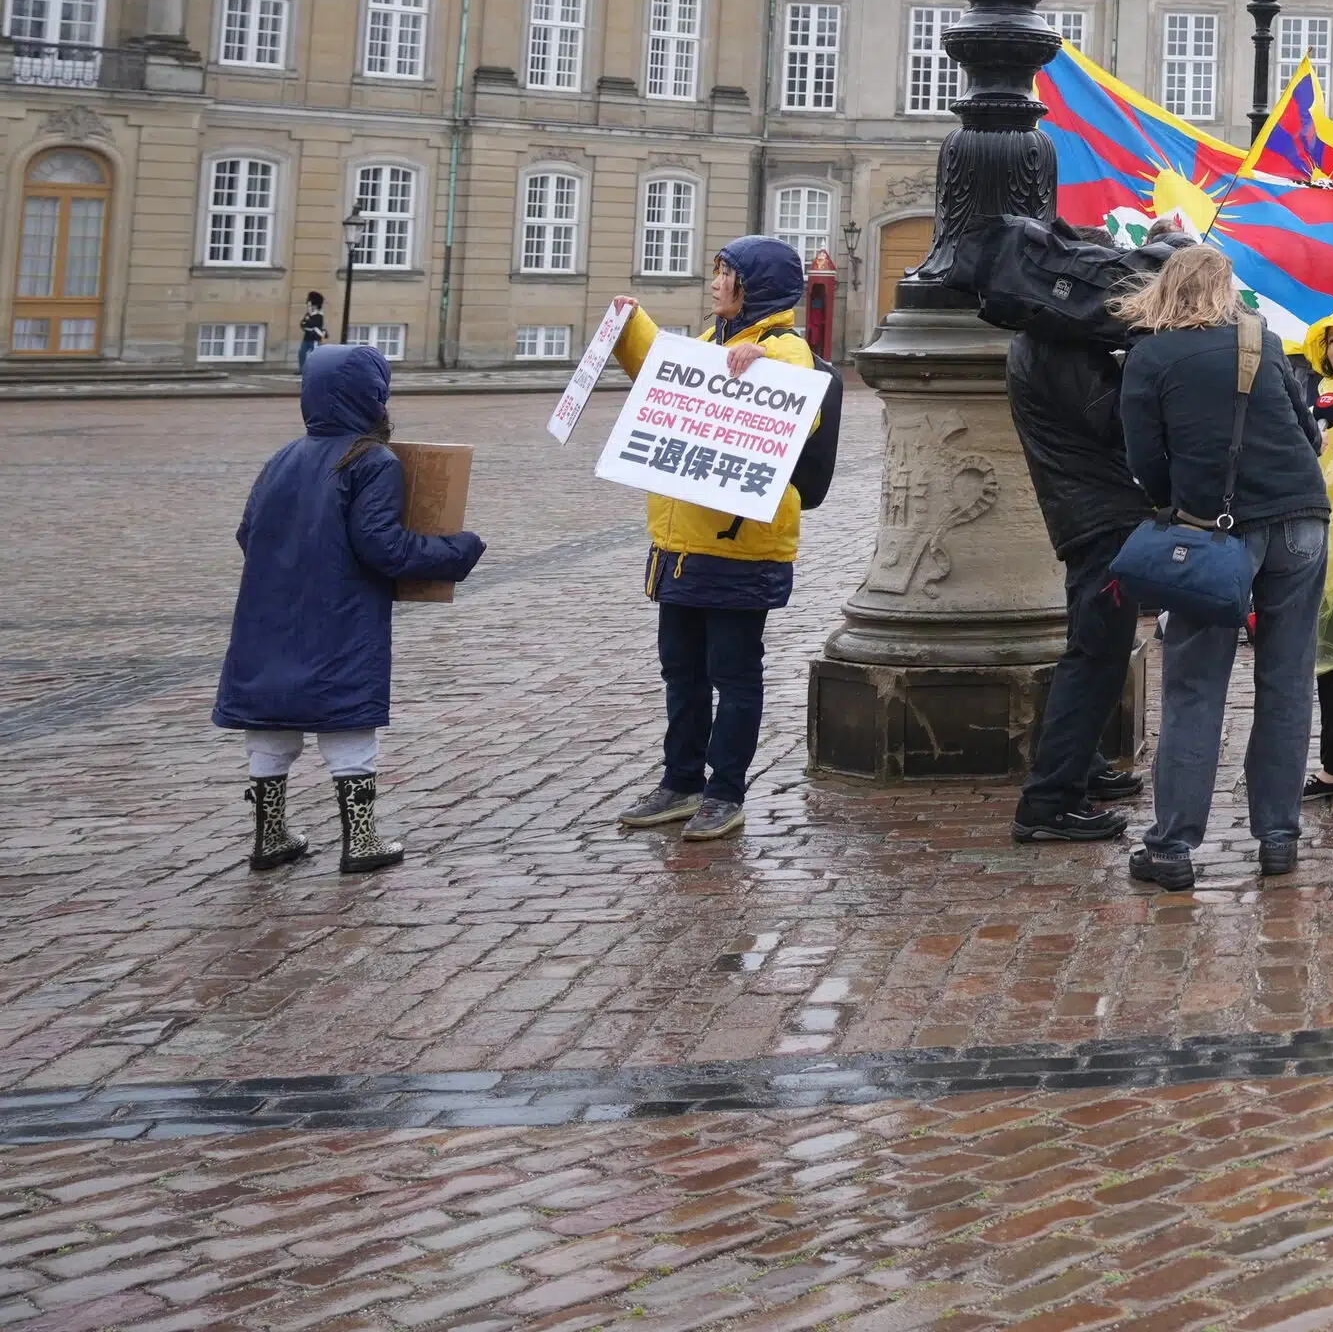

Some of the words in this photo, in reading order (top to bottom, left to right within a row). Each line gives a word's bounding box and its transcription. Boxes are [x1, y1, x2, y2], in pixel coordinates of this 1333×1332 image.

[646, 387, 704, 414] PROTECT
[704, 402, 738, 422] OUR
[735, 410, 796, 438] FREEDOM
[656, 360, 705, 387] END
[707, 374, 807, 415] CCP.COM
[636, 406, 678, 429] SIGN
[680, 416, 711, 439] THE
[713, 426, 789, 458] PETITION
[619, 429, 777, 497] 三退保平安
